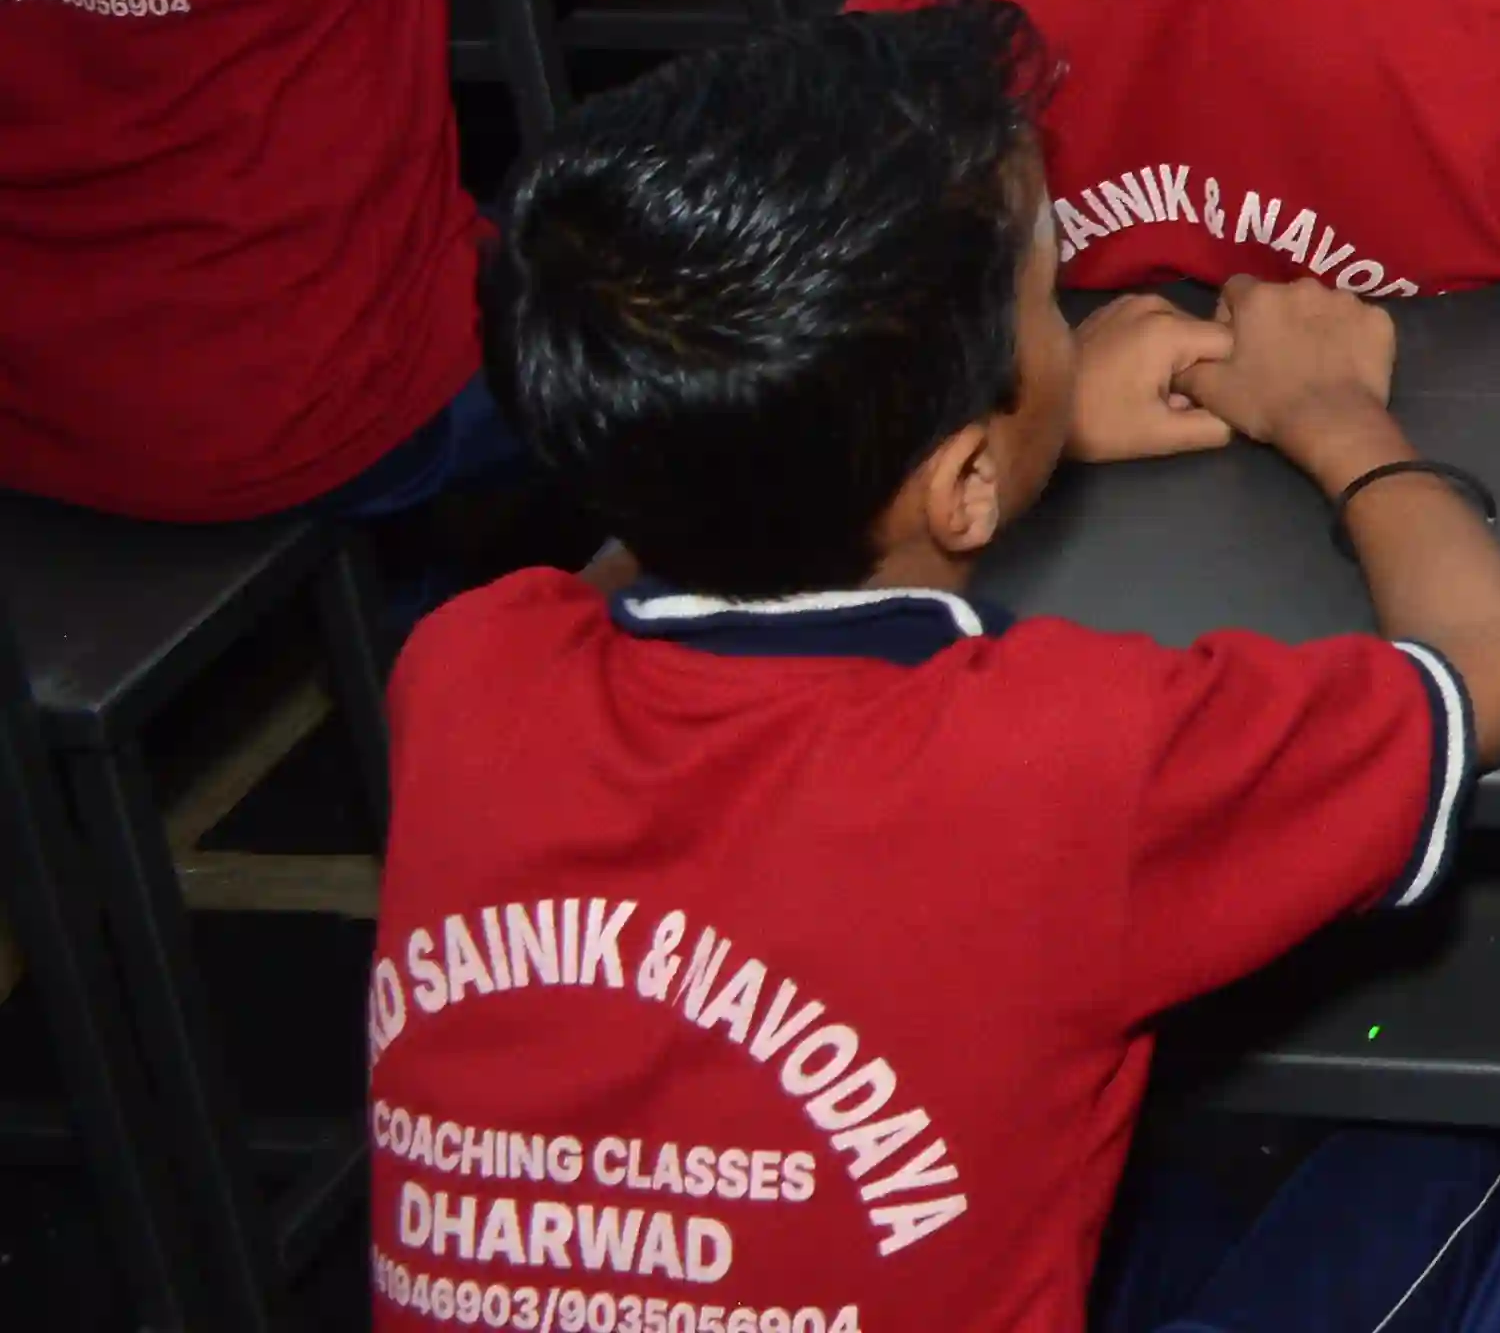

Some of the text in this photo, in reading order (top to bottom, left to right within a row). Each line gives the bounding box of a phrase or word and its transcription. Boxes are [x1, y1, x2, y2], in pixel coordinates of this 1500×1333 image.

[1204, 177, 1225, 239] &
[1235, 191, 1419, 298] NAVO
[408, 897, 968, 1257] SAINIK & NAVODAYA
[373, 1099, 816, 1203] COACHING CLASSES
[400, 1181, 733, 1284] DHARWAD
